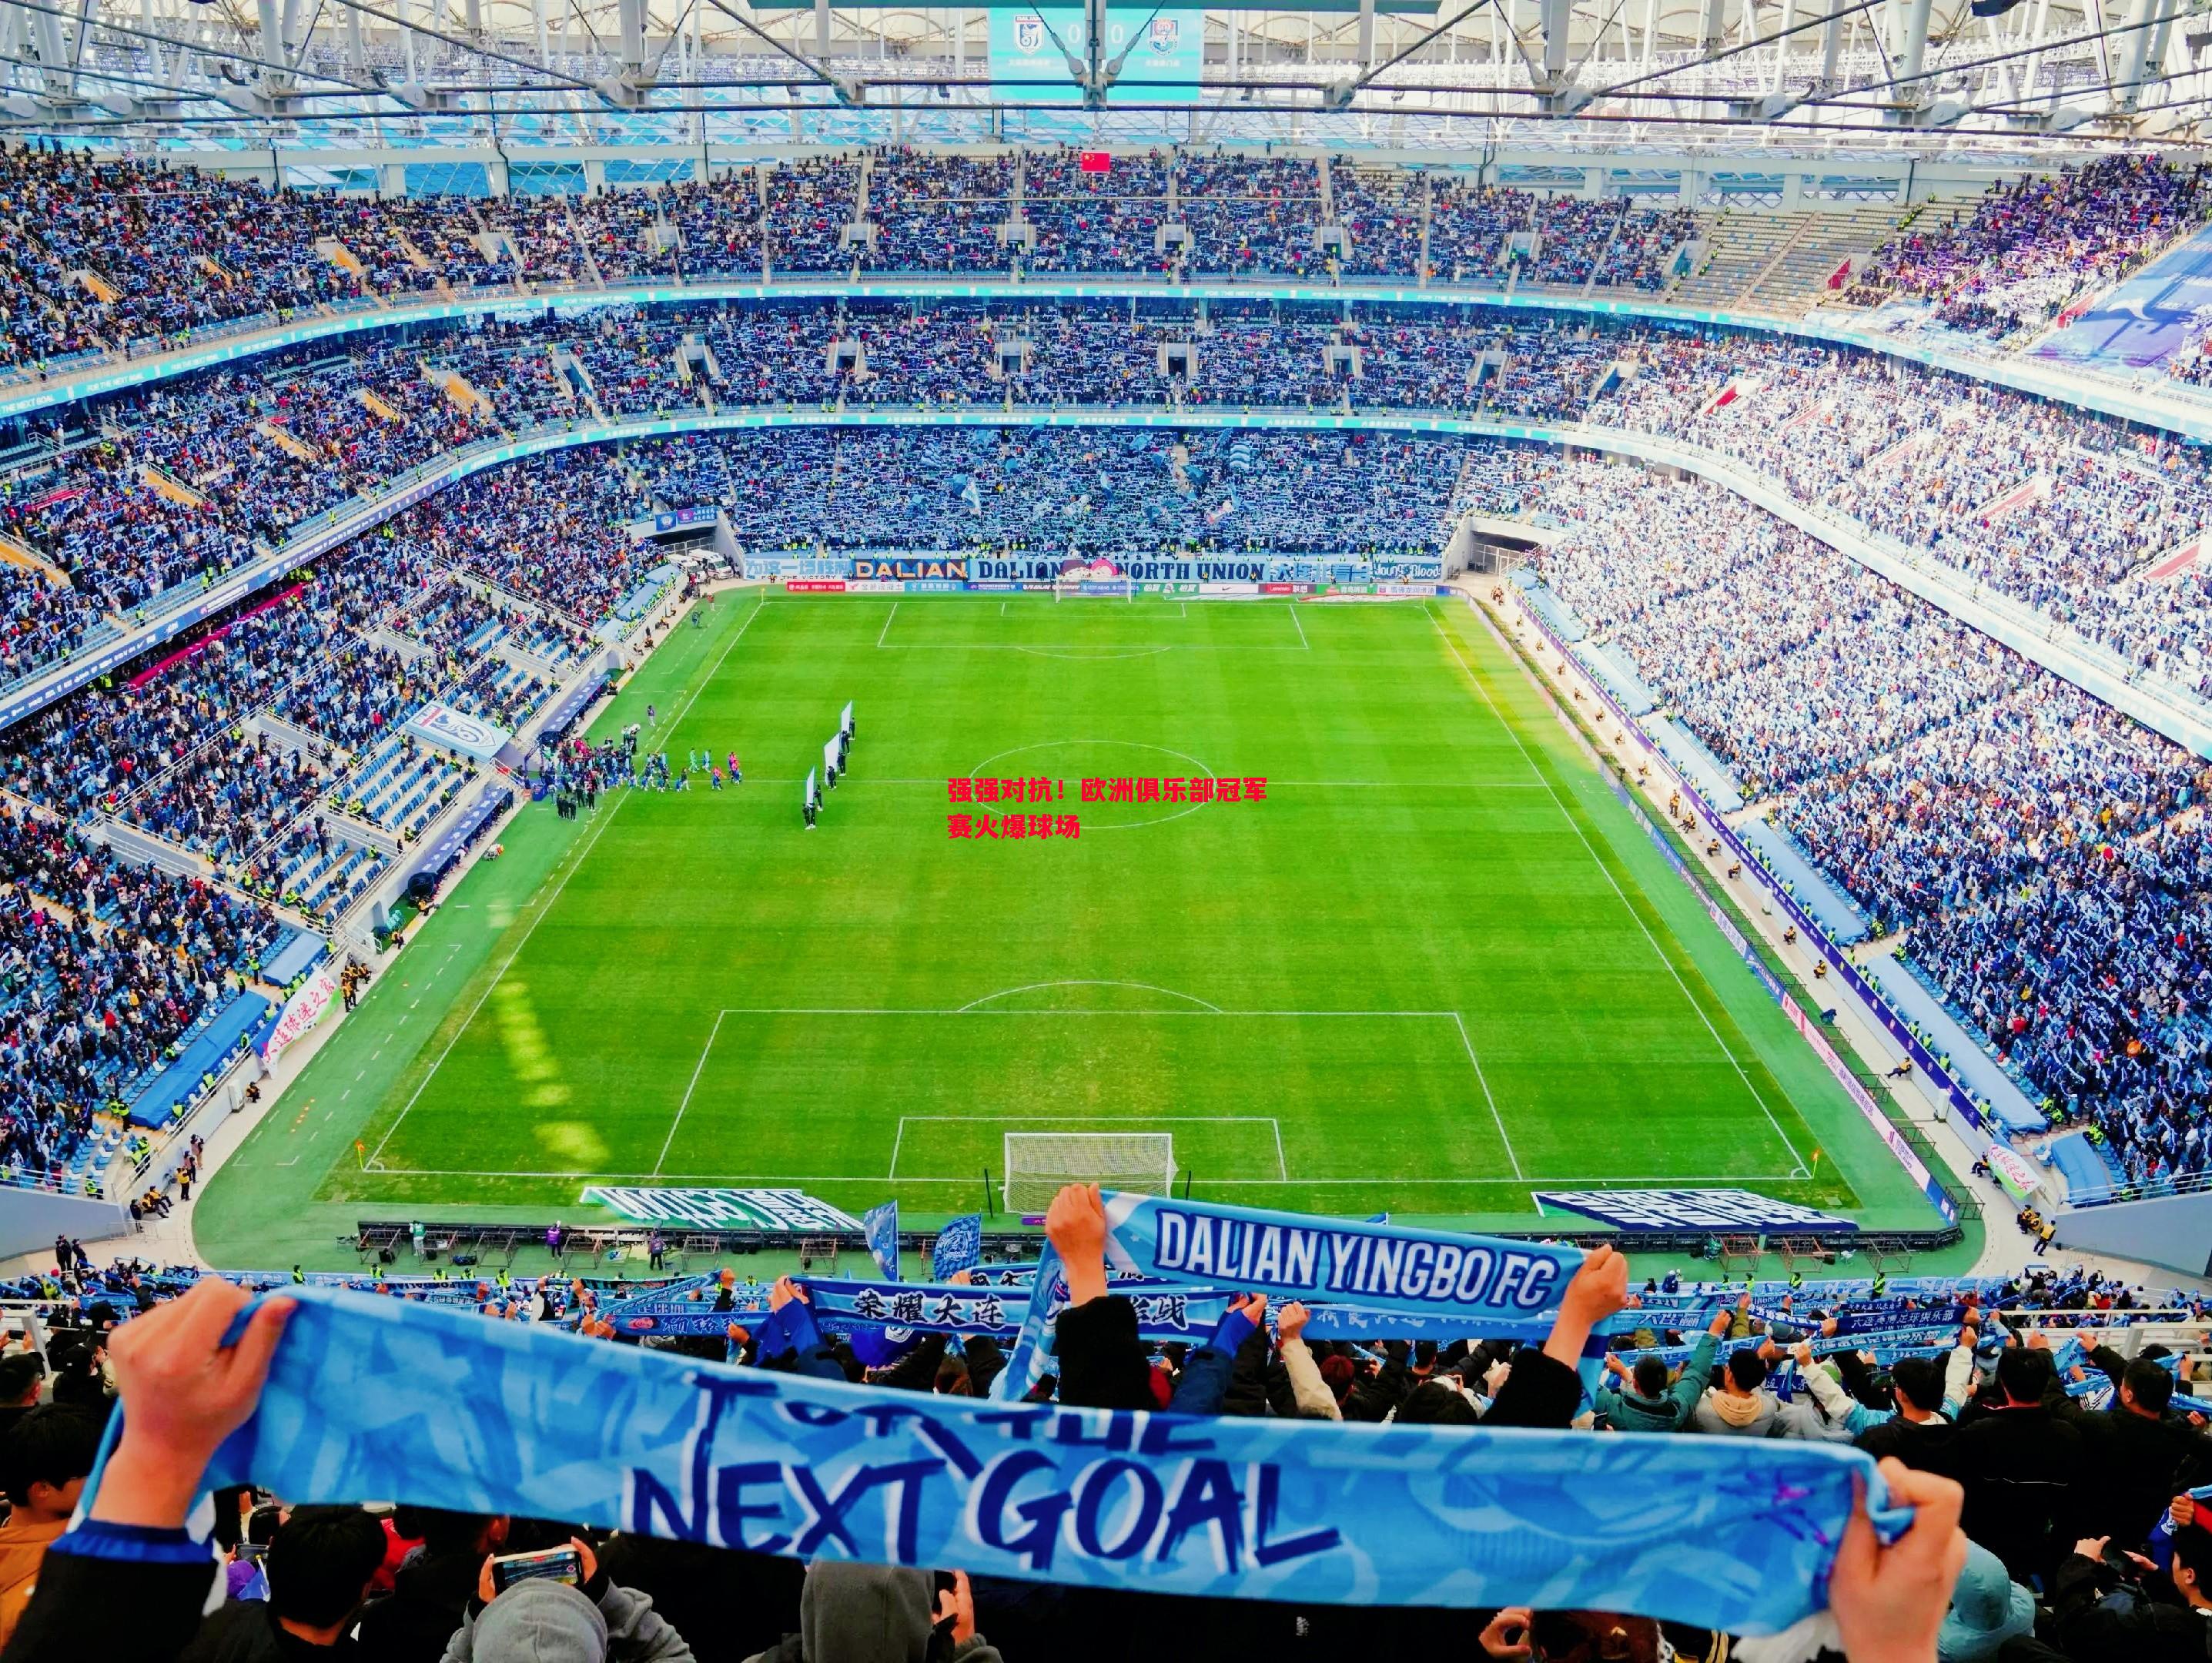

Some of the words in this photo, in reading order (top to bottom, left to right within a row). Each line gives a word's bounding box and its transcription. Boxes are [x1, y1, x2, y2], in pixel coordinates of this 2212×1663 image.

[1067, 24, 1081, 44] 0
[1111, 24, 1123, 44] 0
[855, 561, 965, 577] DALIAN
[1116, 561, 1190, 580] NORTH
[1197, 562, 1265, 579] UNION
[1155, 1208, 1318, 1287] DALIAN
[1325, 1231, 1490, 1300] YINGBO
[1486, 1249, 1557, 1308] FC
[852, 1290, 1006, 1330] 荣耀大连
[622, 1429, 947, 1567] NEXT
[970, 1449, 1341, 1574] GOAL
